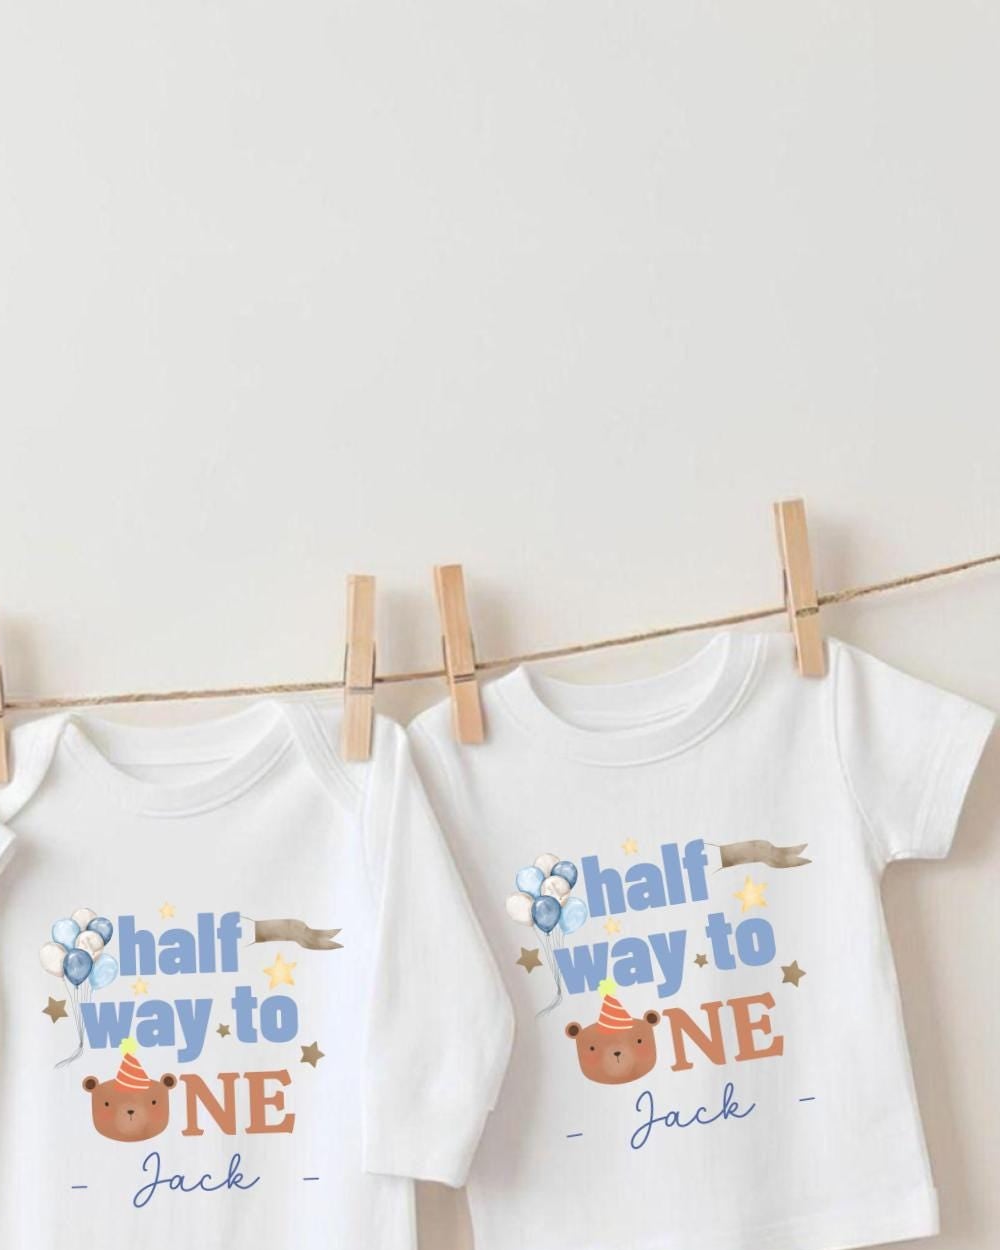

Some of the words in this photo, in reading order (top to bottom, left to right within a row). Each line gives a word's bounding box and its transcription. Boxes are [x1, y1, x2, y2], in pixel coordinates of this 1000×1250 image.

[581, 838, 709, 918] half
[118, 911, 242, 976] half
[553, 929, 687, 999] way
[705, 912, 777, 971] to
[80, 998, 213, 1063] way
[231, 986, 299, 1044] to
[630, 1082, 756, 1150] Jack
[133, 1151, 260, 1208] Jack
